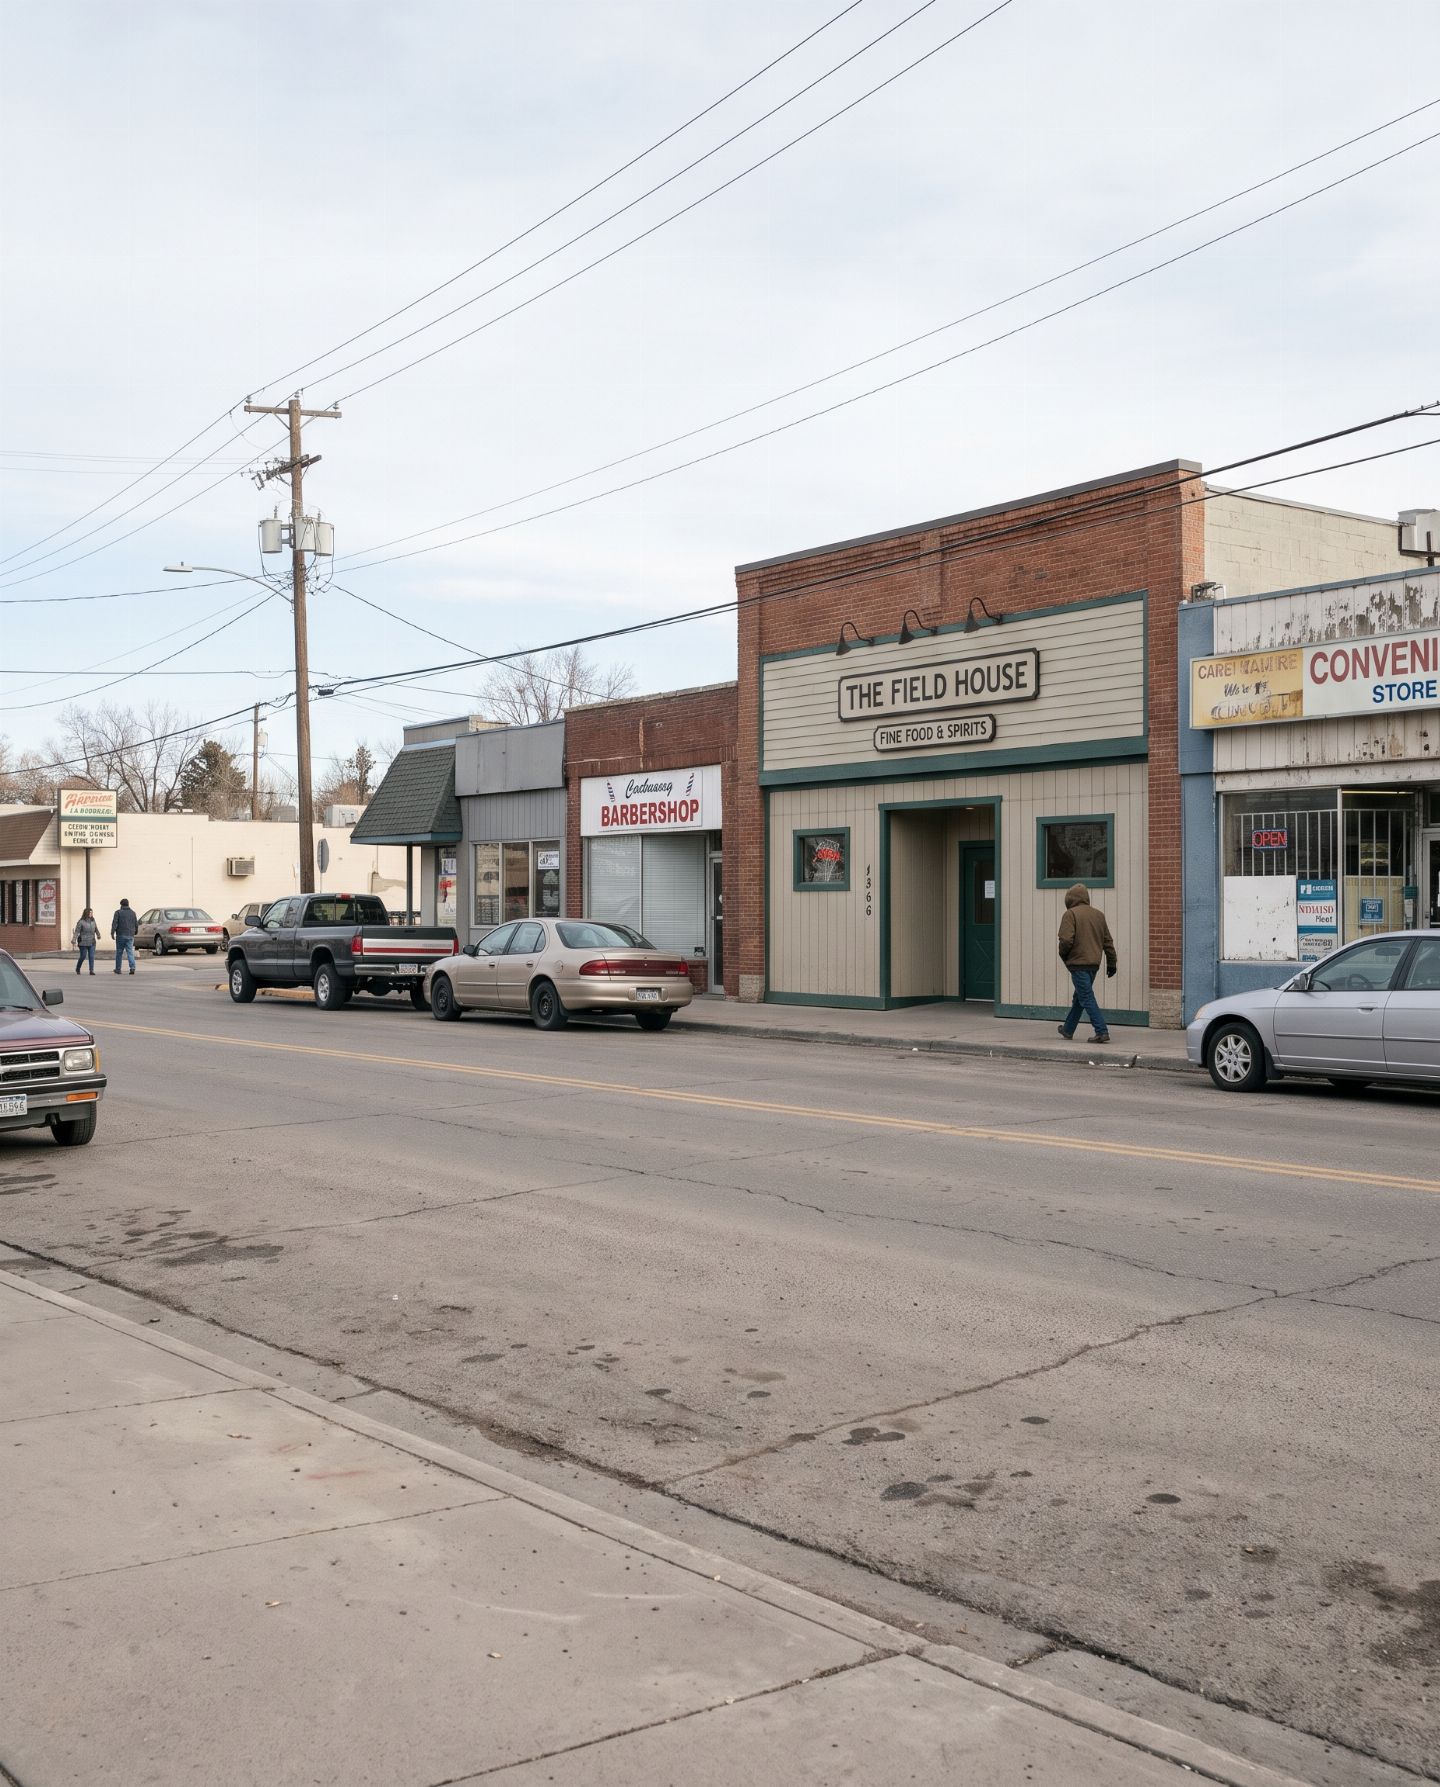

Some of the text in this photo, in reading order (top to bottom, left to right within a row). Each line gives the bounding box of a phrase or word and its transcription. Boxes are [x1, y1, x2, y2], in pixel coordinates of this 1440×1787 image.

[1309, 637, 1439, 685] CONVENI
[846, 660, 1028, 711] THE FIELD HOUSE
[1372, 679, 1438, 703] STORE
[880, 720, 987, 745] FINE FOOD & SPIRITS
[601, 799, 700, 827] BARBERSHOP
[1254, 831, 1287, 847] OPEN
